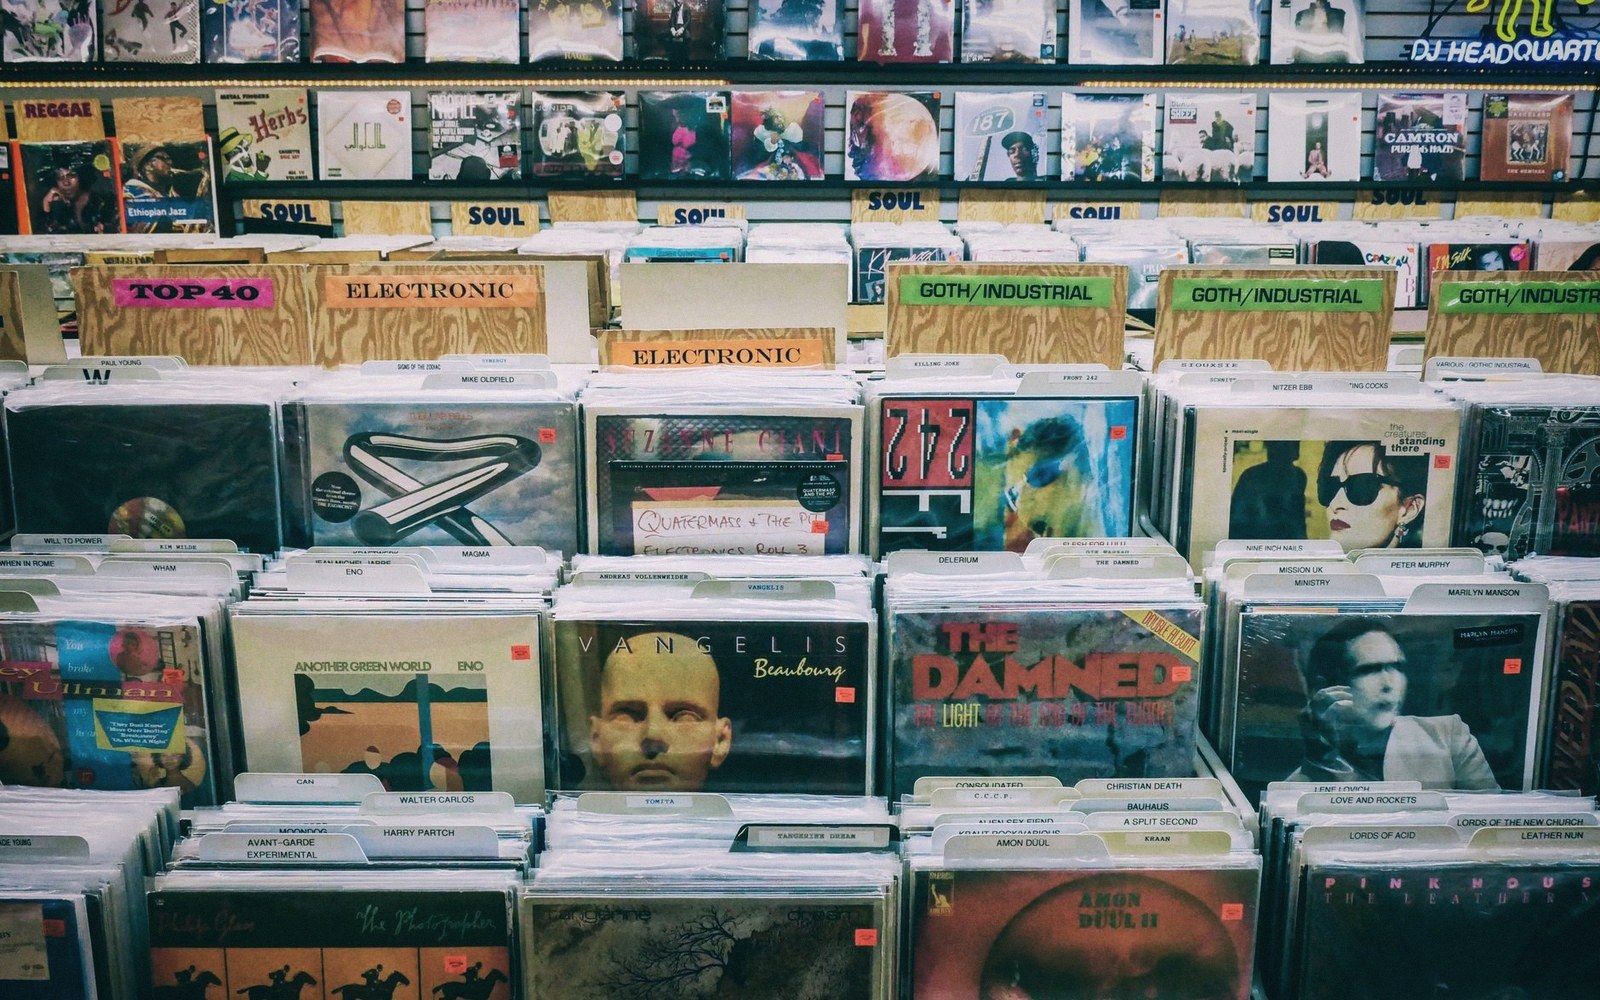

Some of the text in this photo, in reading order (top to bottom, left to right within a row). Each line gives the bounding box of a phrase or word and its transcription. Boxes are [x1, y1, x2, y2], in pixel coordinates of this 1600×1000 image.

[1411, 39, 1441, 61] DJ
[25, 102, 92, 119] REGGAE
[248, 106, 307, 143] Herbs
[971, 111, 1011, 132] 187
[1383, 132, 1458, 144] CAM'RON
[868, 191, 924, 211] SOUL
[1372, 190, 1426, 205] SOUL
[128, 207, 187, 220] Ethiopian Jazz
[259, 203, 317, 223] SOUL
[469, 206, 525, 226] SOUL
[1268, 205, 1323, 223] SOUL
[129, 284, 259, 300] TOP 40
[345, 282, 514, 300] ELECTRONIC
[919, 282, 1092, 302] GOTH/INDUSTRIAL
[1192, 287, 1362, 306] GOTH/INDUSTRIAL
[633, 346, 801, 365] ELECTRONIC
[1272, 383, 1313, 391] NITZER EBB
[1390, 422, 1404, 431] the
[1384, 430, 1427, 438] creatures
[1391, 444, 1419, 452] there
[1399, 437, 1446, 447] standing
[757, 513, 792, 528] THE
[44, 537, 102, 545] WILL TO POWER
[462, 550, 490, 558] MAGMA
[756, 543, 792, 555] ROLL
[797, 544, 808, 555] 3
[938, 556, 978, 564] DELERIUM
[1391, 561, 1451, 569] PETER MURPHY
[346, 568, 363, 576] ENO
[1279, 566, 1310, 574] MISSION
[1294, 579, 1330, 587] MINISTRY
[1448, 588, 1520, 597] MARILYN MANSON
[940, 621, 1019, 653] THE
[1141, 611, 1196, 655] DOUBLE ALBUM
[64, 639, 84, 651] You
[578, 635, 847, 654] VANGELIS
[295, 661, 484, 672] ANOTHER GREEN WORLD ENO
[753, 656, 846, 683] Beaubourg
[912, 651, 1188, 700] DAMNED
[941, 702, 982, 728] LIGHT
[1106, 781, 1182, 790] CHRISTIAN DEATH
[399, 796, 475, 804] WALTER CARLOS
[1330, 795, 1417, 805] LOVE AND ROCKETS
[1127, 803, 1169, 811] BAUHAUS
[1123, 817, 1198, 825] A SPLIT SECOND
[1456, 817, 1583, 827] LORDS OF THE NEW CHURCH
[383, 828, 455, 837] HARRY PARTCH
[1349, 831, 1416, 840] LORDS OF ACID
[1521, 830, 1584, 840] LEATHER NUN
[247, 838, 315, 847] AVANT-GARDE
[996, 838, 1024, 847] AMON
[247, 850, 317, 859] EXPERIMENTAL
[1325, 877, 1440, 890] PINK
[1079, 890, 1141, 908] AMON
[1324, 892, 1555, 904] THE LEATHER
[356, 904, 496, 942] The Photographer
